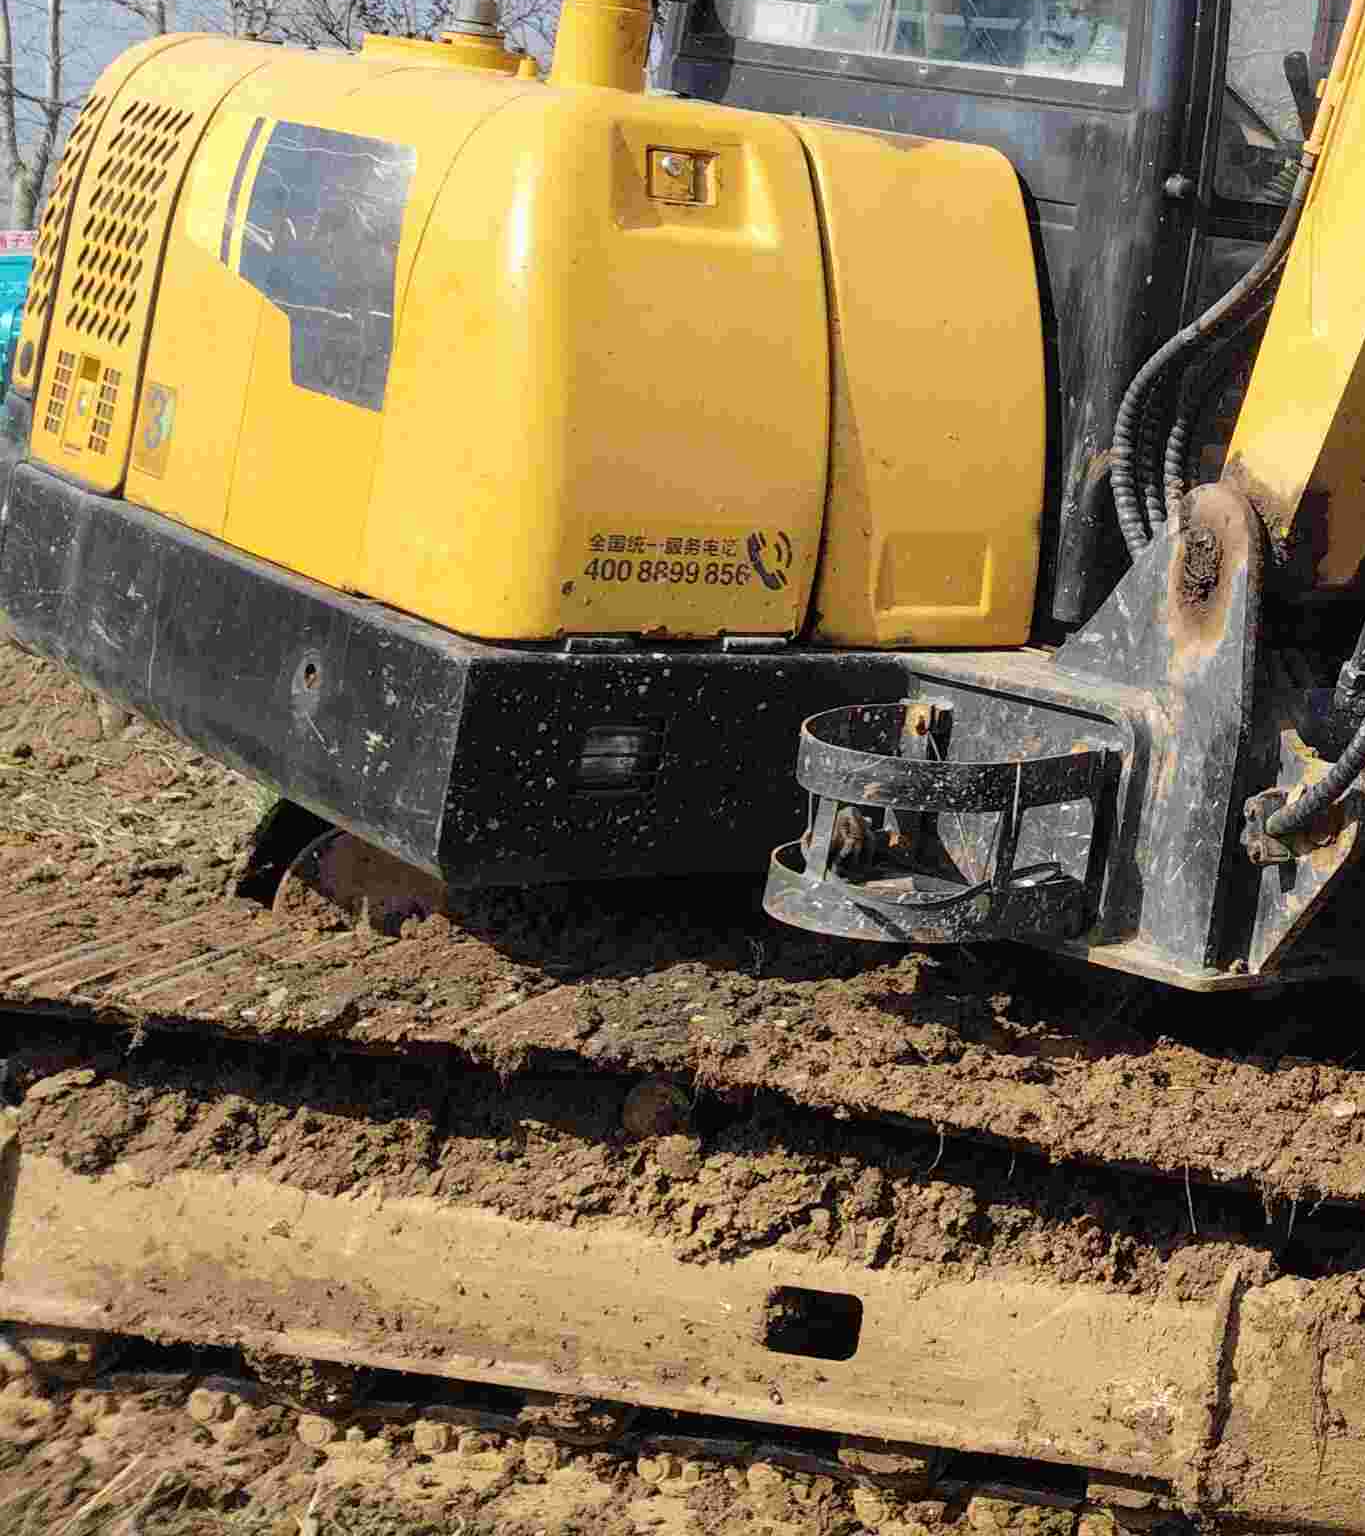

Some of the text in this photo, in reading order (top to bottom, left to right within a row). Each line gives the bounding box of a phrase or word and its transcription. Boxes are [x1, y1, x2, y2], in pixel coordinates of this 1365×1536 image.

[587, 532, 738, 558] 全国统一服务电话
[584, 558, 751, 587] 400 8899 856
